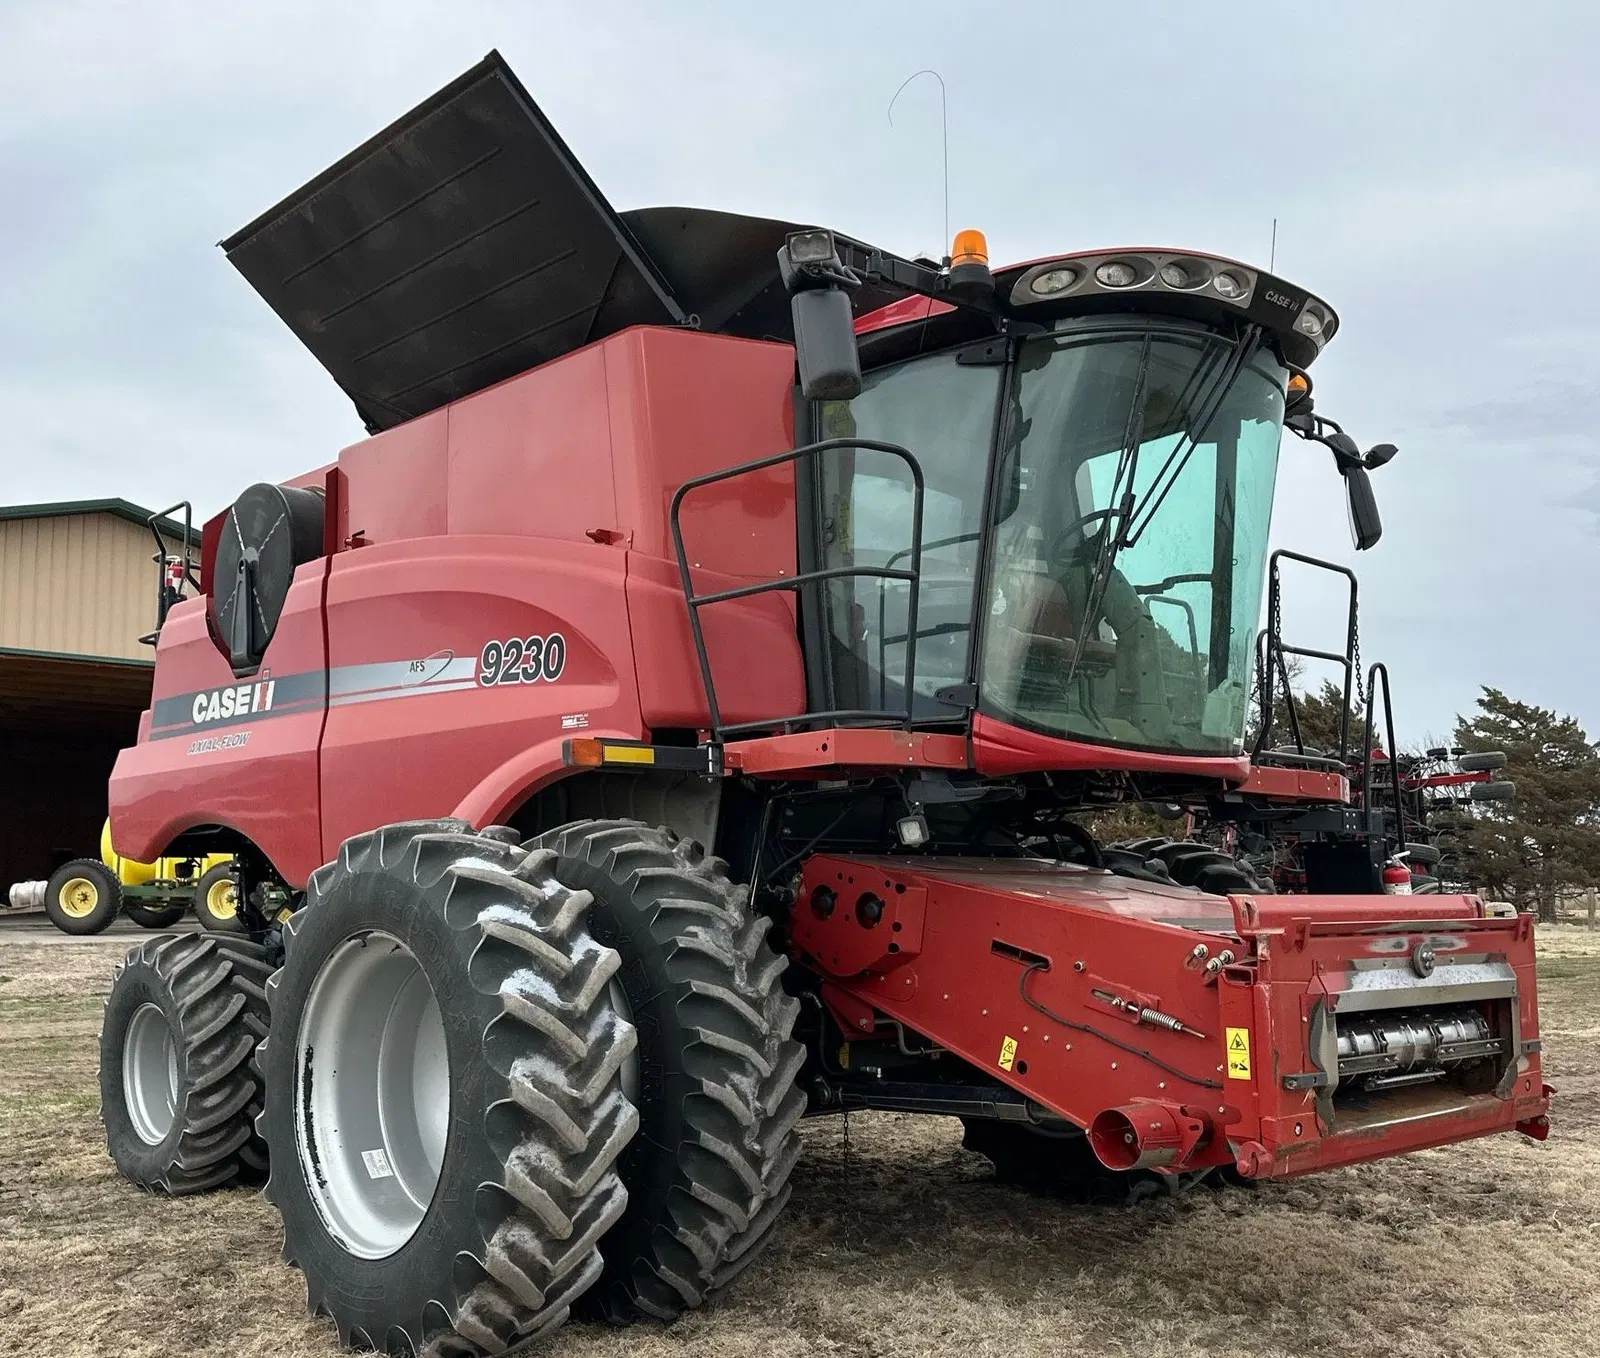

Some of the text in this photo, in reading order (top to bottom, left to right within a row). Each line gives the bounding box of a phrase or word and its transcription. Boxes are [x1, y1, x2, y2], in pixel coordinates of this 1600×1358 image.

[1265, 290, 1291, 308] CASE
[409, 660, 425, 673] AFS
[480, 633, 566, 687] 9230
[187, 731, 252, 756] AXIAL-FLOW
